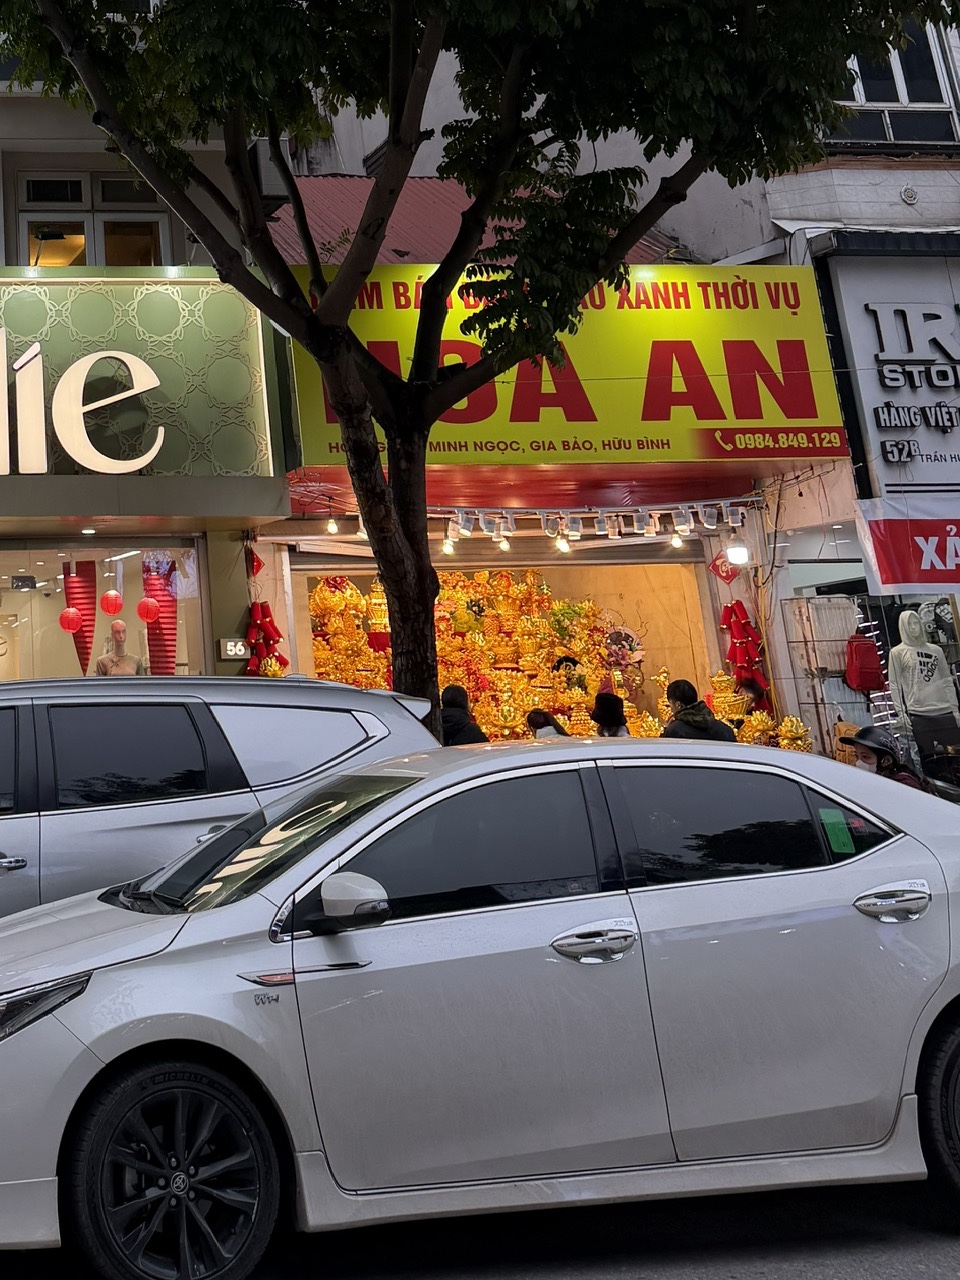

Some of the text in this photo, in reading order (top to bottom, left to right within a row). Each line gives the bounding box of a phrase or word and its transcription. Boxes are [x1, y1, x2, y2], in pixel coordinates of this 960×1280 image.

[616, 281, 691, 310] XANH
[697, 274, 759, 310] THỜI
[764, 281, 801, 316] VỤ
[865, 303, 960, 363] IR
[641, 339, 819, 422] AN
[878, 363, 960, 389] STO
[875, 401, 959, 434] HÀNG VIỆT
[429, 436, 671, 456] MINH NGỌC, GIA BẢO, HỮU BÌNH
[735, 432, 841, 449] 0984.849.129
[226, 641, 245, 655] 56
